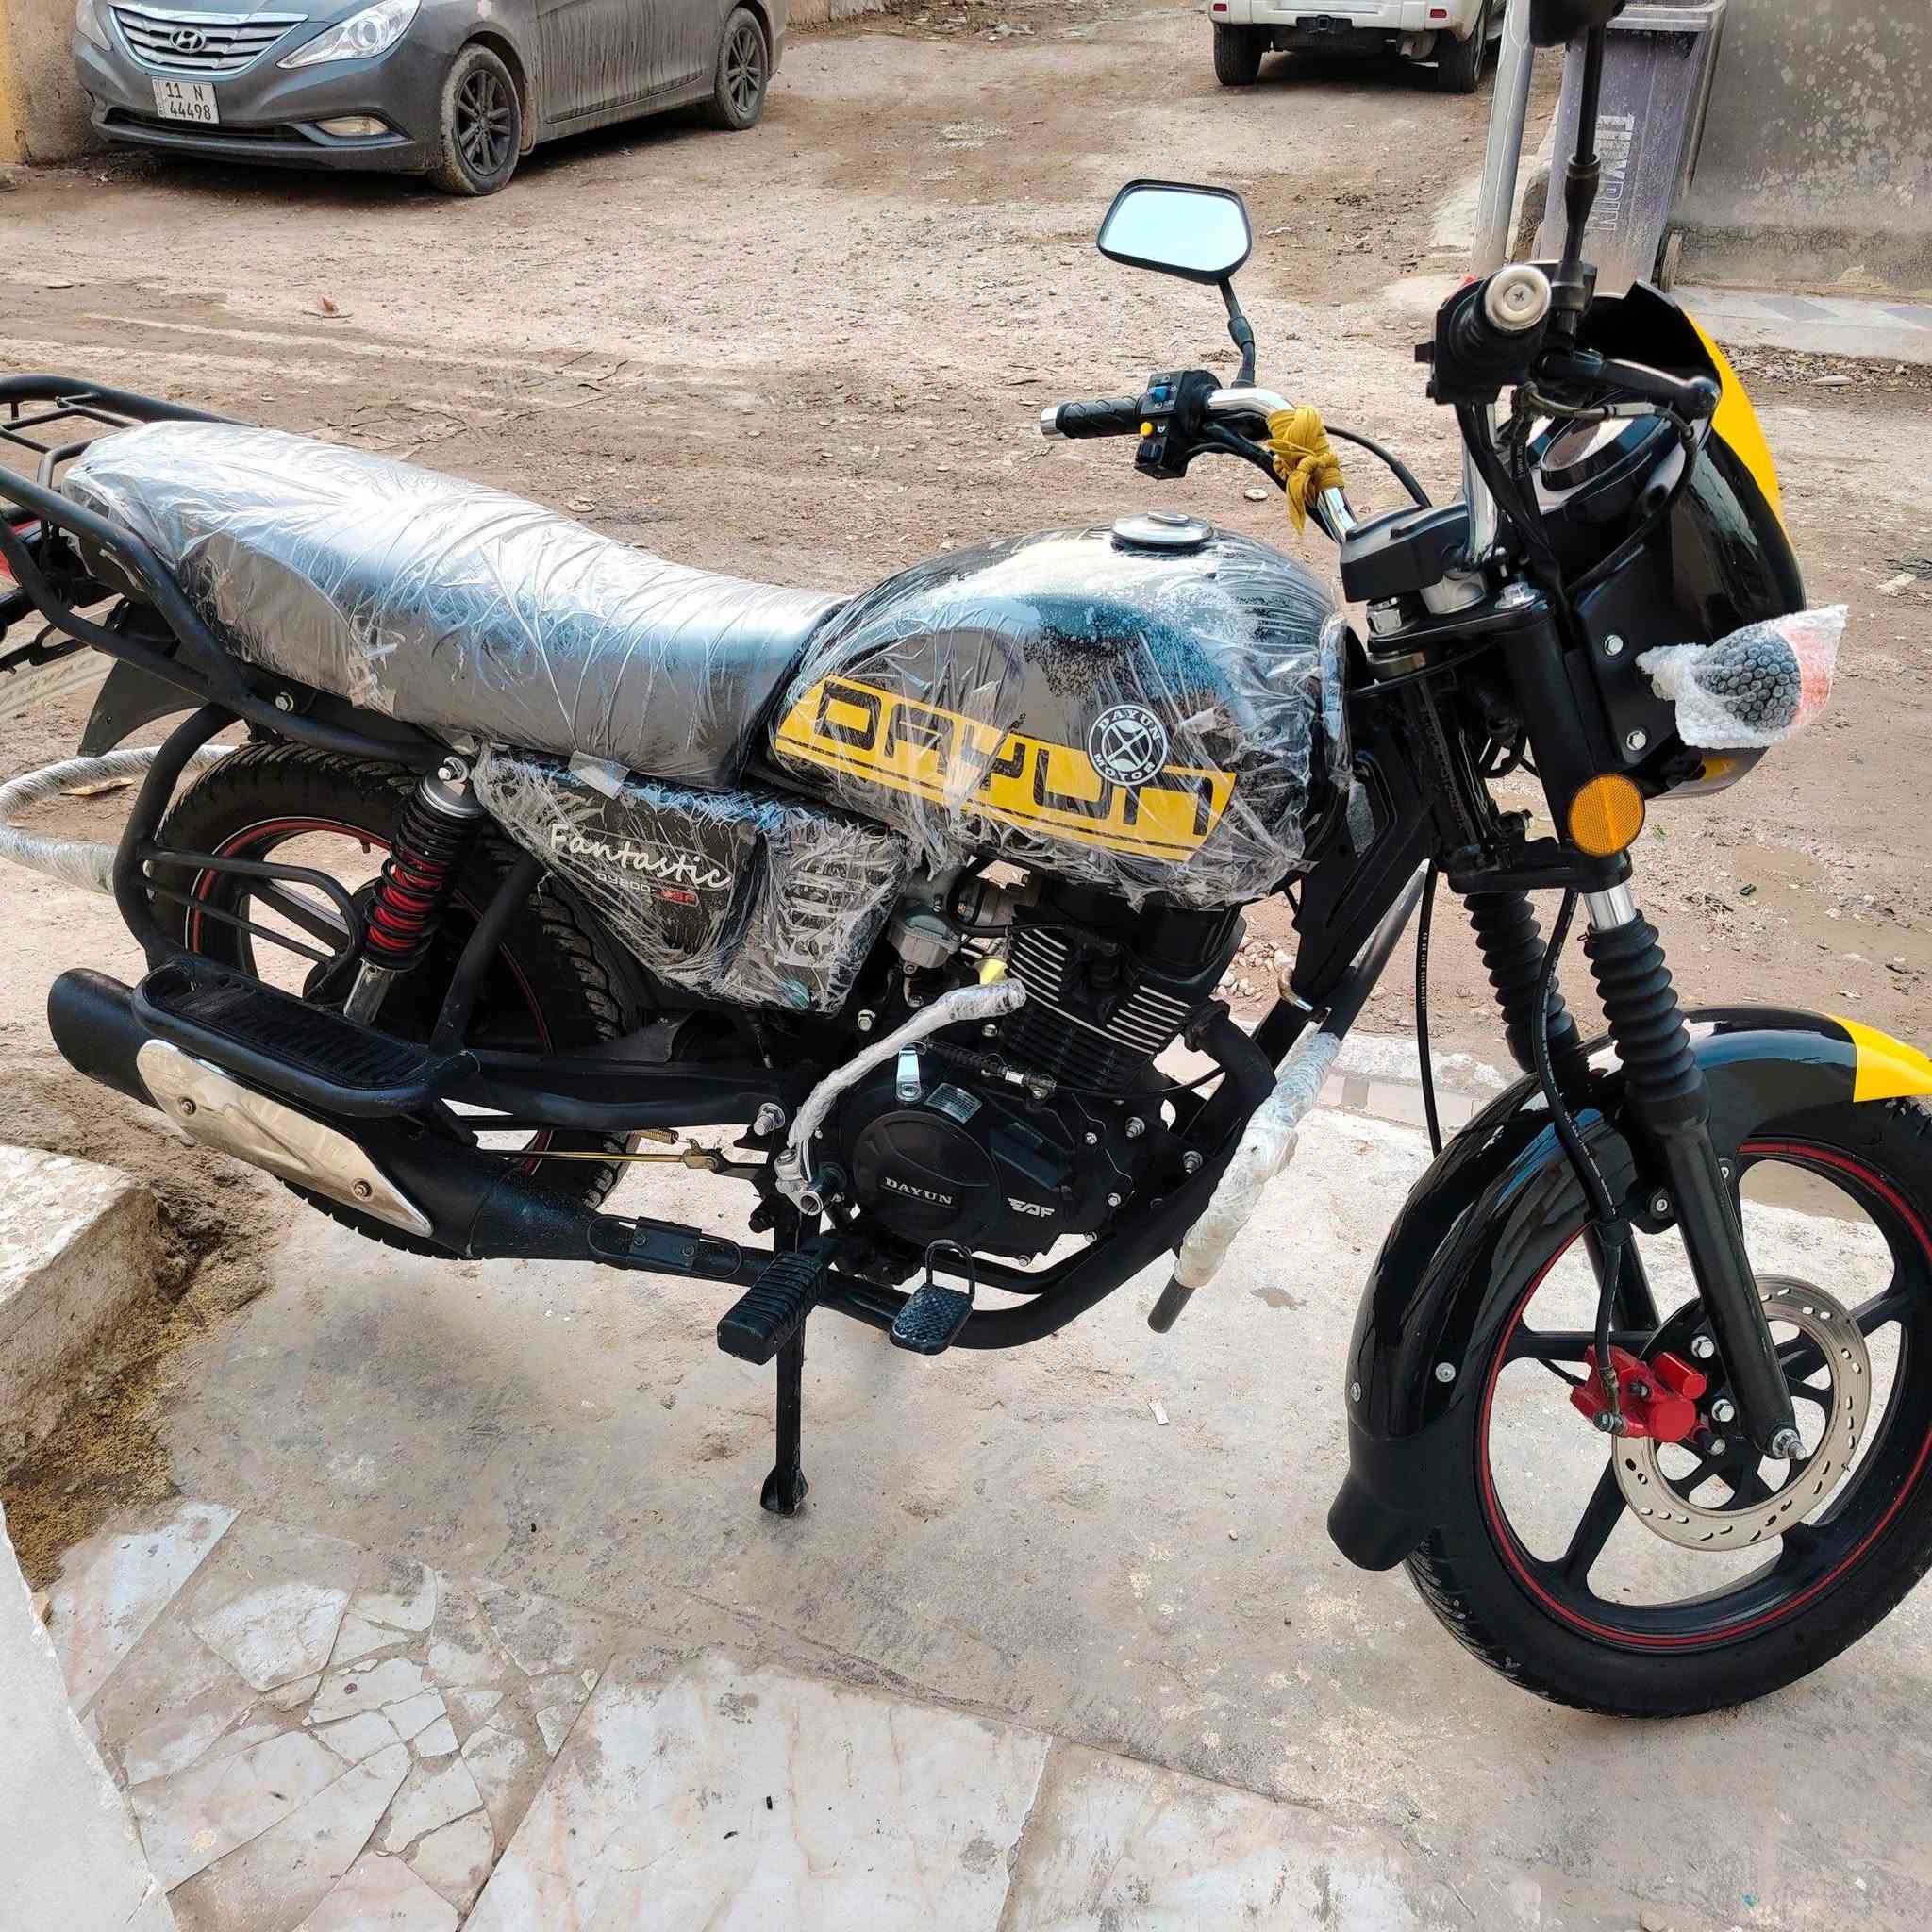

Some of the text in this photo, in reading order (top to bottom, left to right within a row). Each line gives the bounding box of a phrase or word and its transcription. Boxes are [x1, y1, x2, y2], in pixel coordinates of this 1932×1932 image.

[165, 81, 205, 101] 11 N
[170, 101, 212, 121] 44498
[1097, 708, 1162, 741] DAYUN
[1094, 753, 1156, 781] MOTOR
[550, 823, 732, 889] Fantastic
[884, 1176, 953, 1205] DAYUN
